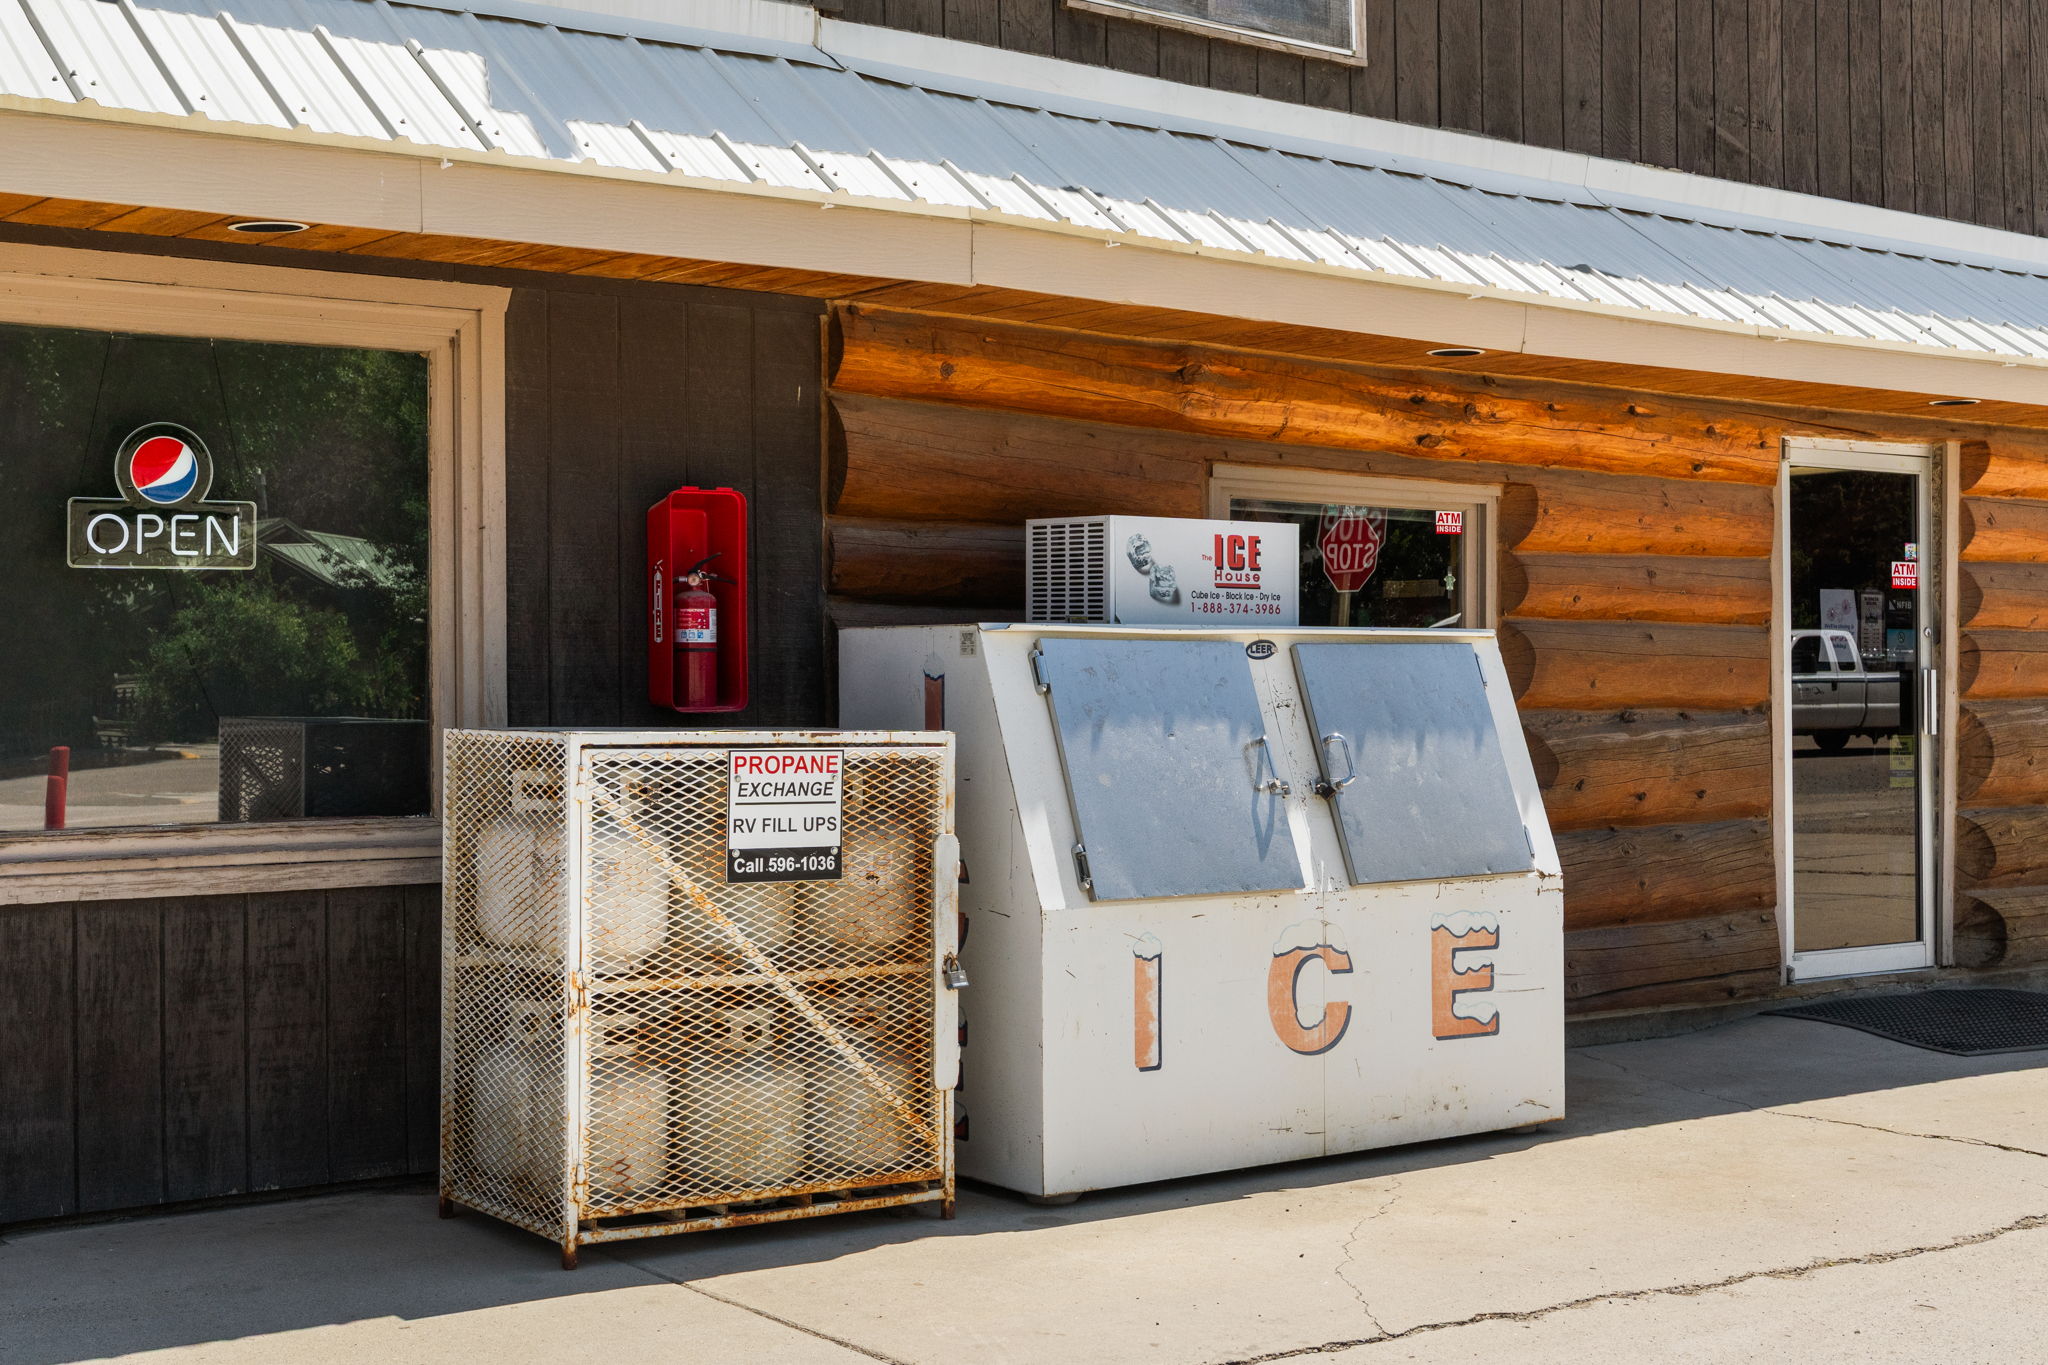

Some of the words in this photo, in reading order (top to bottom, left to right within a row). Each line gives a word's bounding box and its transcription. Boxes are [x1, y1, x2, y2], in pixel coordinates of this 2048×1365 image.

[1437, 512, 1460, 523] ATM
[87, 513, 239, 556] OPEN
[1436, 525, 1462, 533] INSIDE
[1201, 554, 1213, 562] The
[1214, 534, 1262, 572] ICE
[1214, 569, 1261, 582] House
[1893, 563, 1915, 575] ATM
[1892, 577, 1916, 586] INSIDE
[1191, 590, 1208, 600] Cube
[1225, 591, 1242, 601] Block
[1259, 592, 1270, 603] Dry
[1191, 602, 1281, 615] 1-888-374-3986
[1250, 644, 1272, 654] LEER
[734, 755, 839, 774] PROPANE
[737, 781, 834, 797] EXCHANGE
[733, 817, 756, 833] RV
[762, 817, 798, 833] FILL
[803, 816, 837, 832] UPS
[733, 857, 764, 873] Call
[768, 855, 836, 873] 596-1036
[1133, 910, 1501, 1073] ICE
